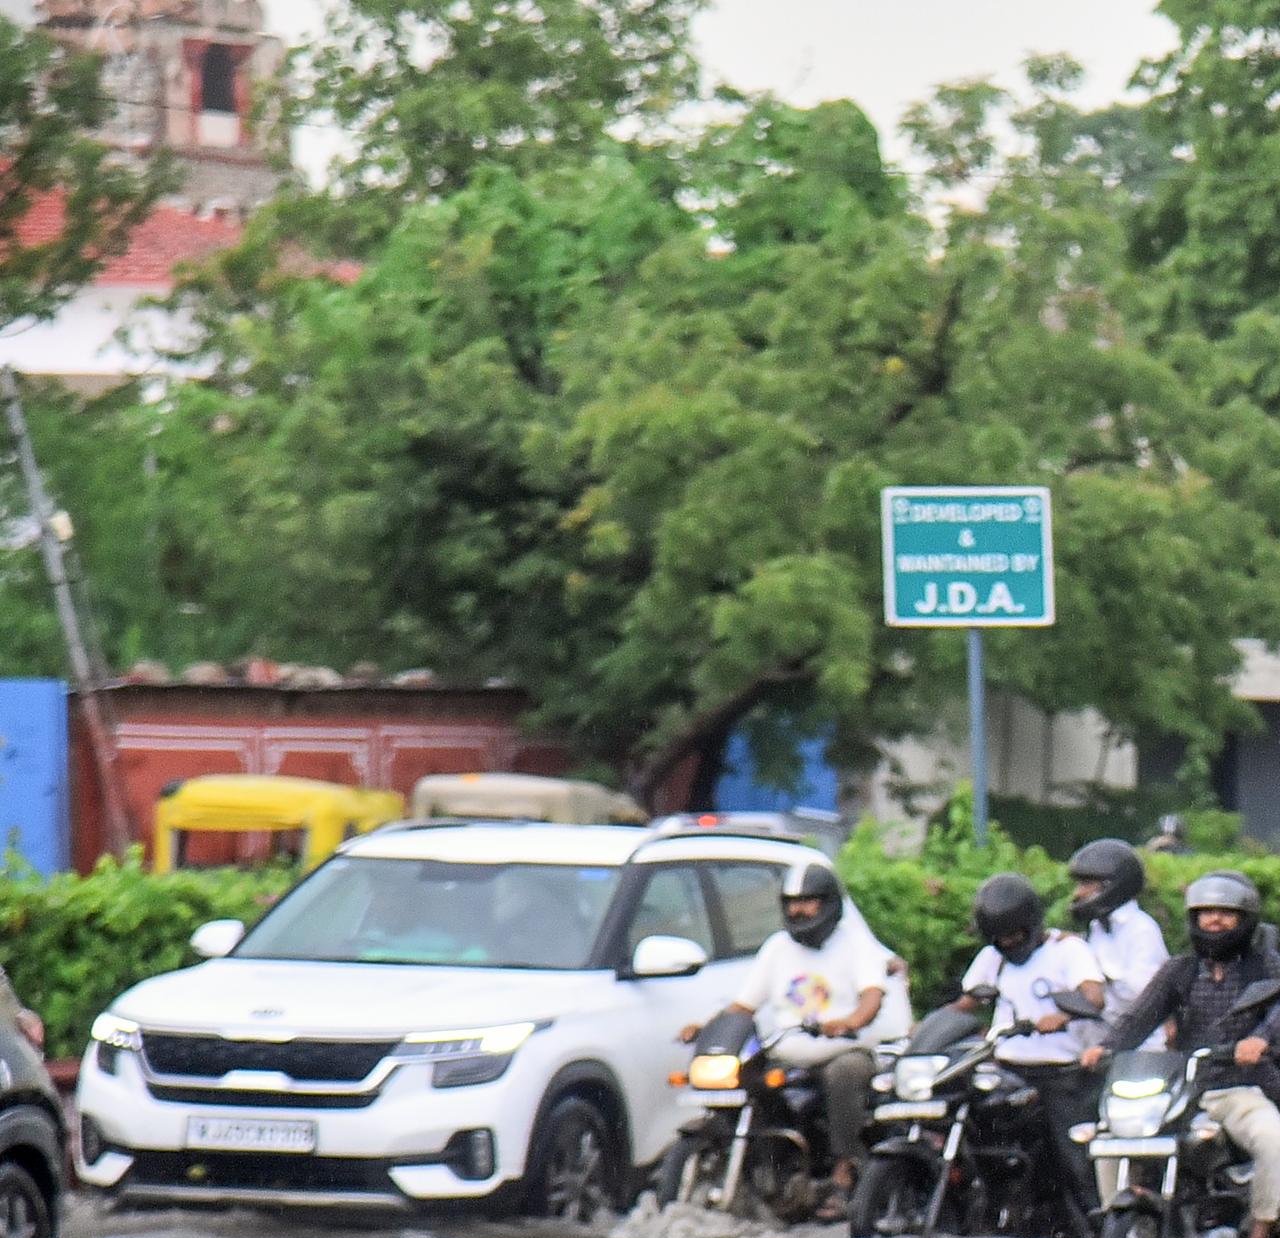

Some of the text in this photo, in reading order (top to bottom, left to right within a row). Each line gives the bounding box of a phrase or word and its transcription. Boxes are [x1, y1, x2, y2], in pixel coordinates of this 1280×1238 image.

[911, 502, 1023, 524] DEVELOPED
[957, 527, 976, 548] &
[898, 553, 1041, 573] MAINTAINED BY
[914, 580, 1025, 615] J.D.A.
